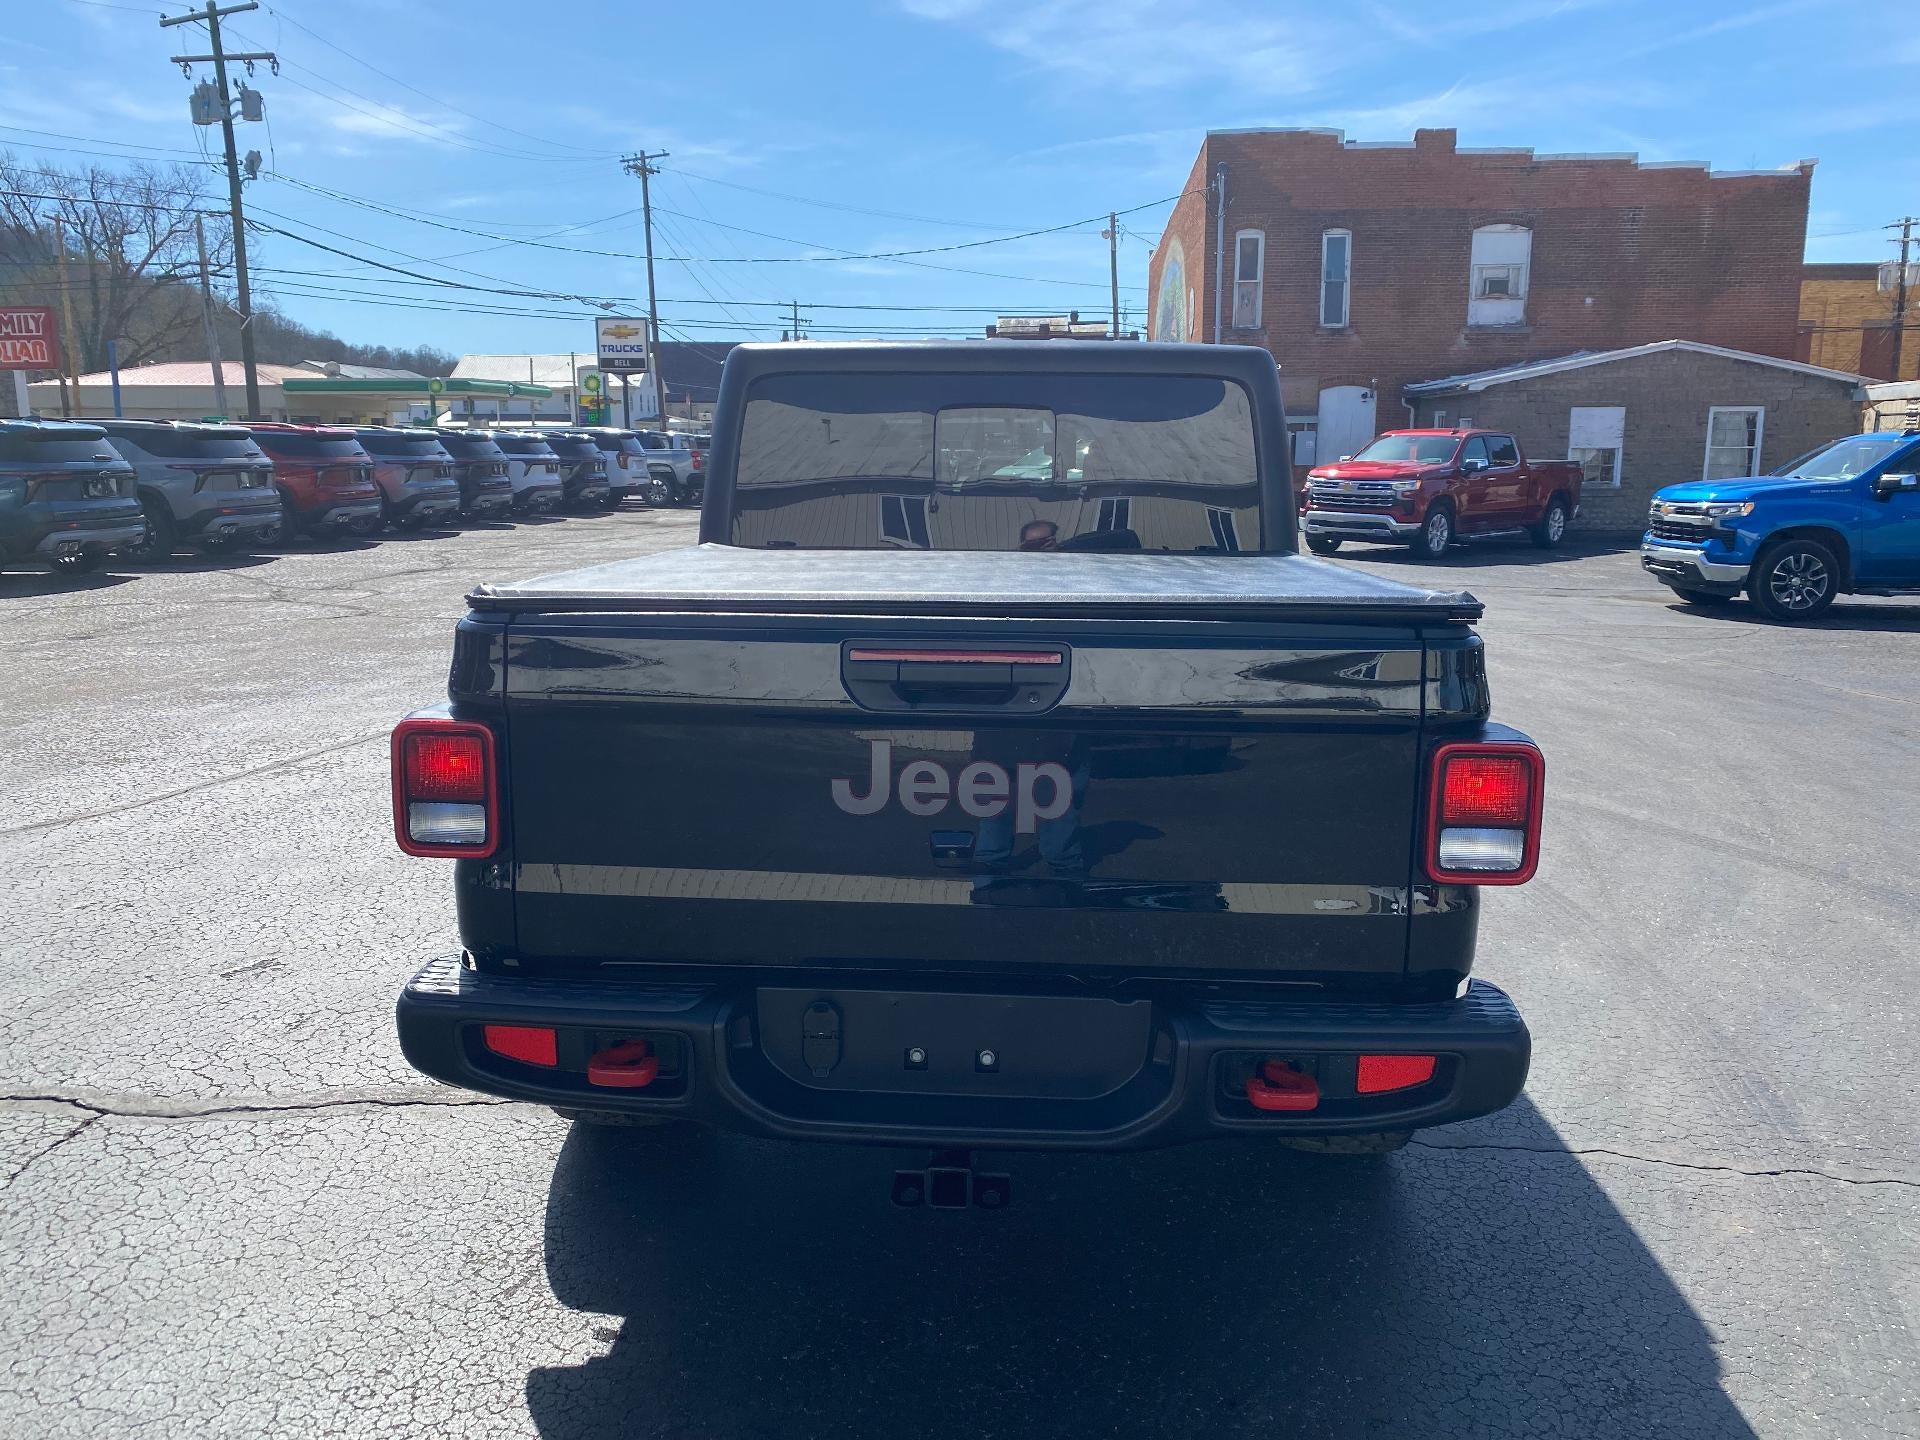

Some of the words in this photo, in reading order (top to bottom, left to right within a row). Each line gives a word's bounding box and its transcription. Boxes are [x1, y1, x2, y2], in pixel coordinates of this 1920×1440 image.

[0, 340, 48, 362] LLAR
[601, 344, 643, 353] TRUCKS
[614, 359, 631, 367] BELL
[831, 739, 1073, 834] Jeep
